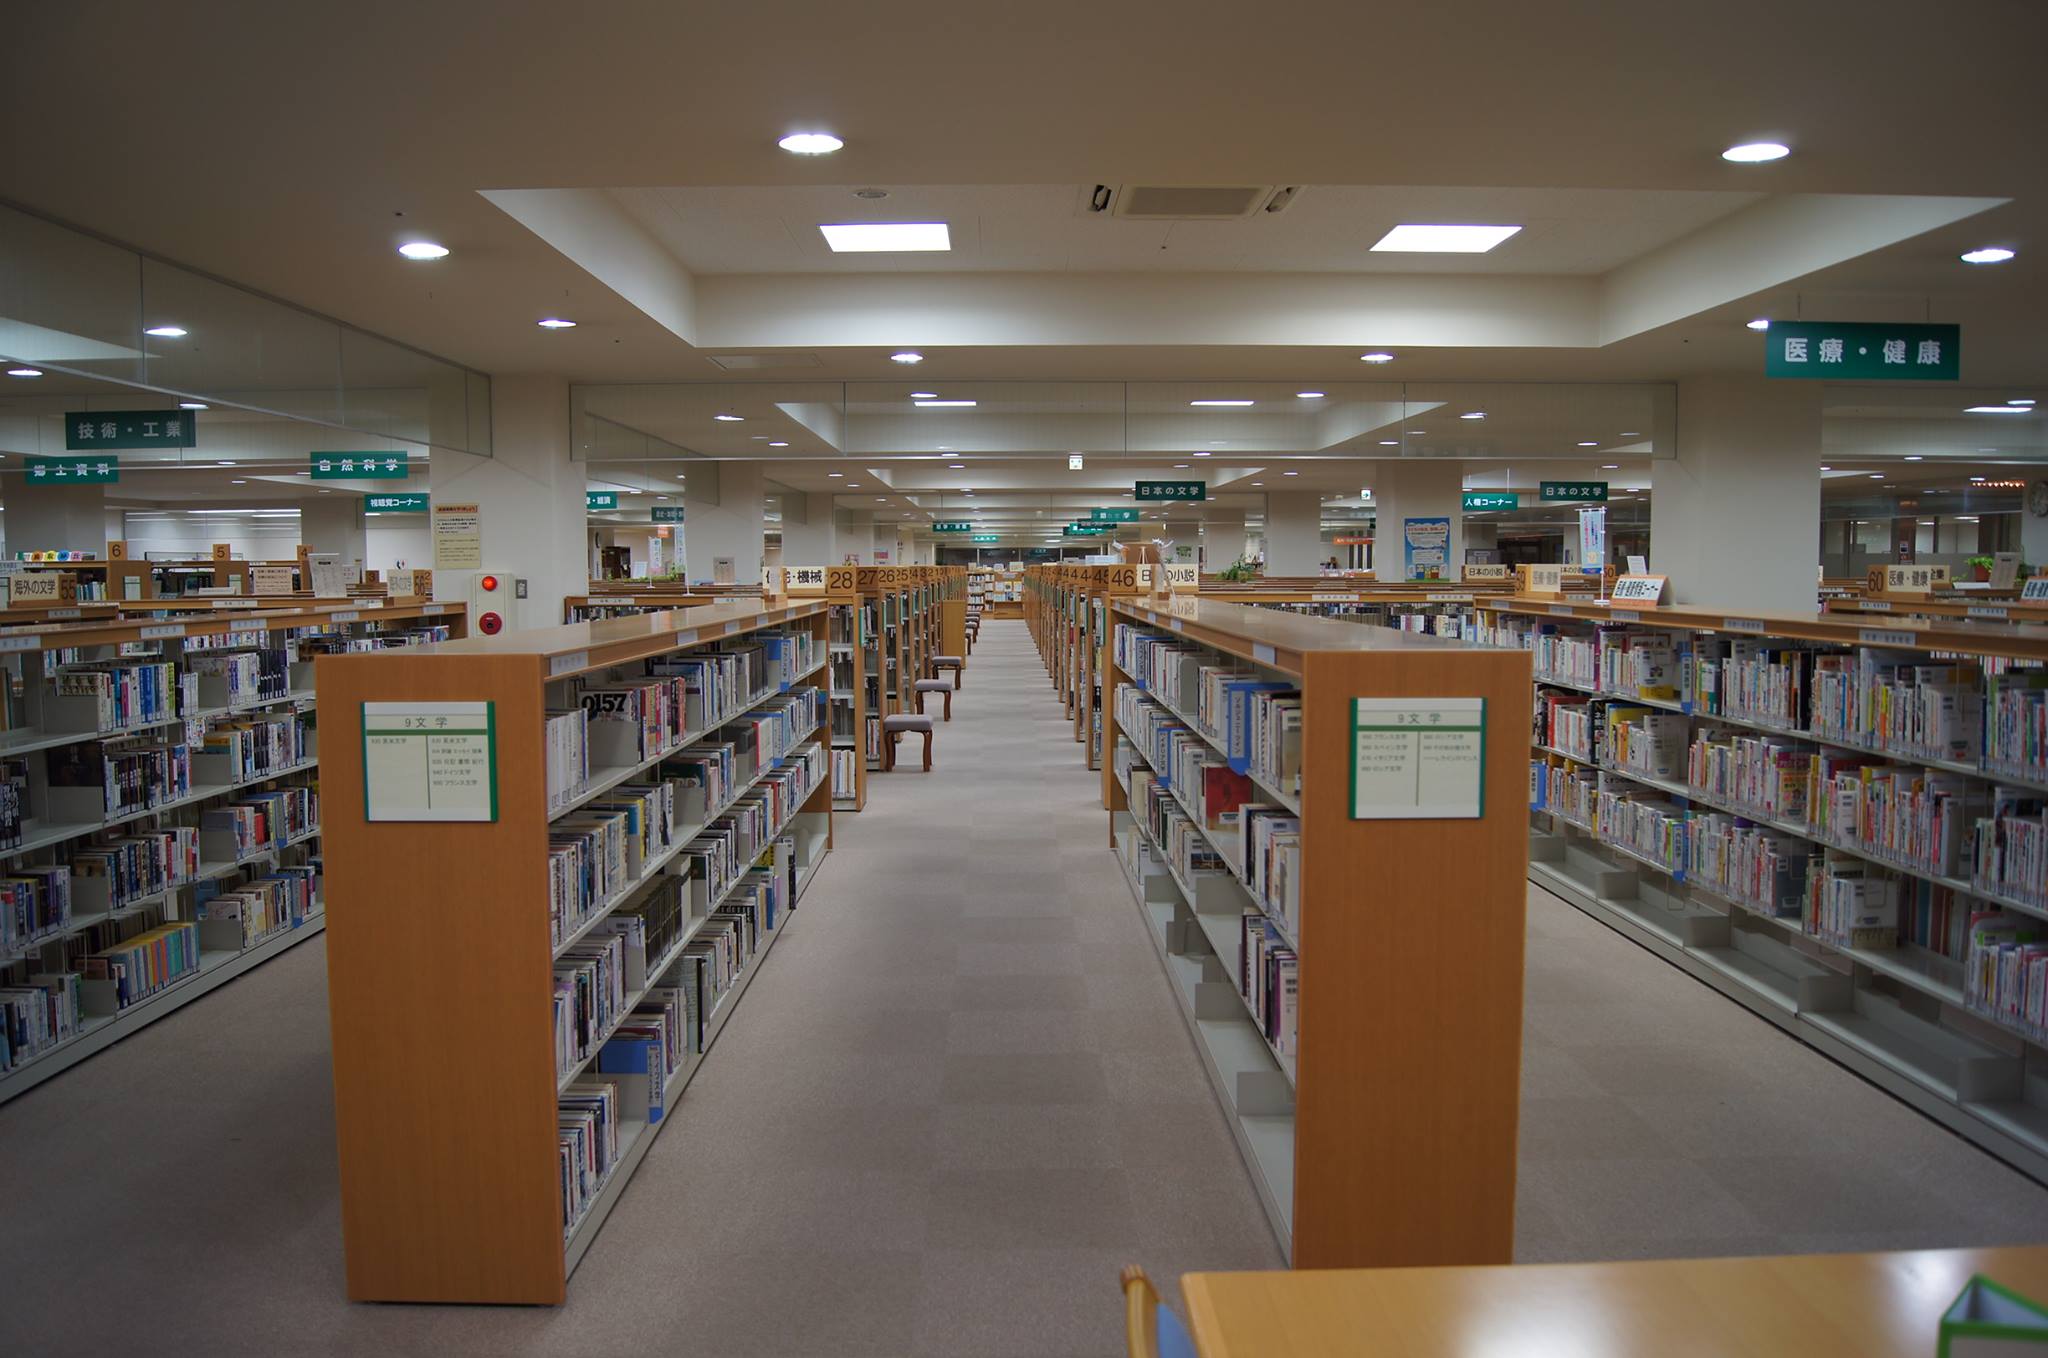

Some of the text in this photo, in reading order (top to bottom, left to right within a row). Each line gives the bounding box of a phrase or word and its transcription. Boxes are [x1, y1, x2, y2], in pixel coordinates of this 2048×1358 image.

[1785, 338, 1941, 365] 医療・健康
[77, 420, 181, 439] 技術・工業
[319, 458, 398, 472] 自然科学
[1141, 486, 1199, 496] 日本の文学
[1545, 487, 1602, 496] 日本の文学
[112, 544, 121, 557] 6
[216, 546, 225, 558] 5
[369, 571, 375, 582] 3
[858, 570, 878, 585] 27
[879, 570, 895, 583] 26
[1112, 569, 1134, 587] 46
[1469, 568, 1503, 576] 日本の小説
[1889, 570, 1928, 587] 医療・健康
[14, 579, 56, 595] 海外の文学
[830, 571, 853, 589] 28
[1868, 571, 1884, 591] 60
[61, 578, 76, 599] 55
